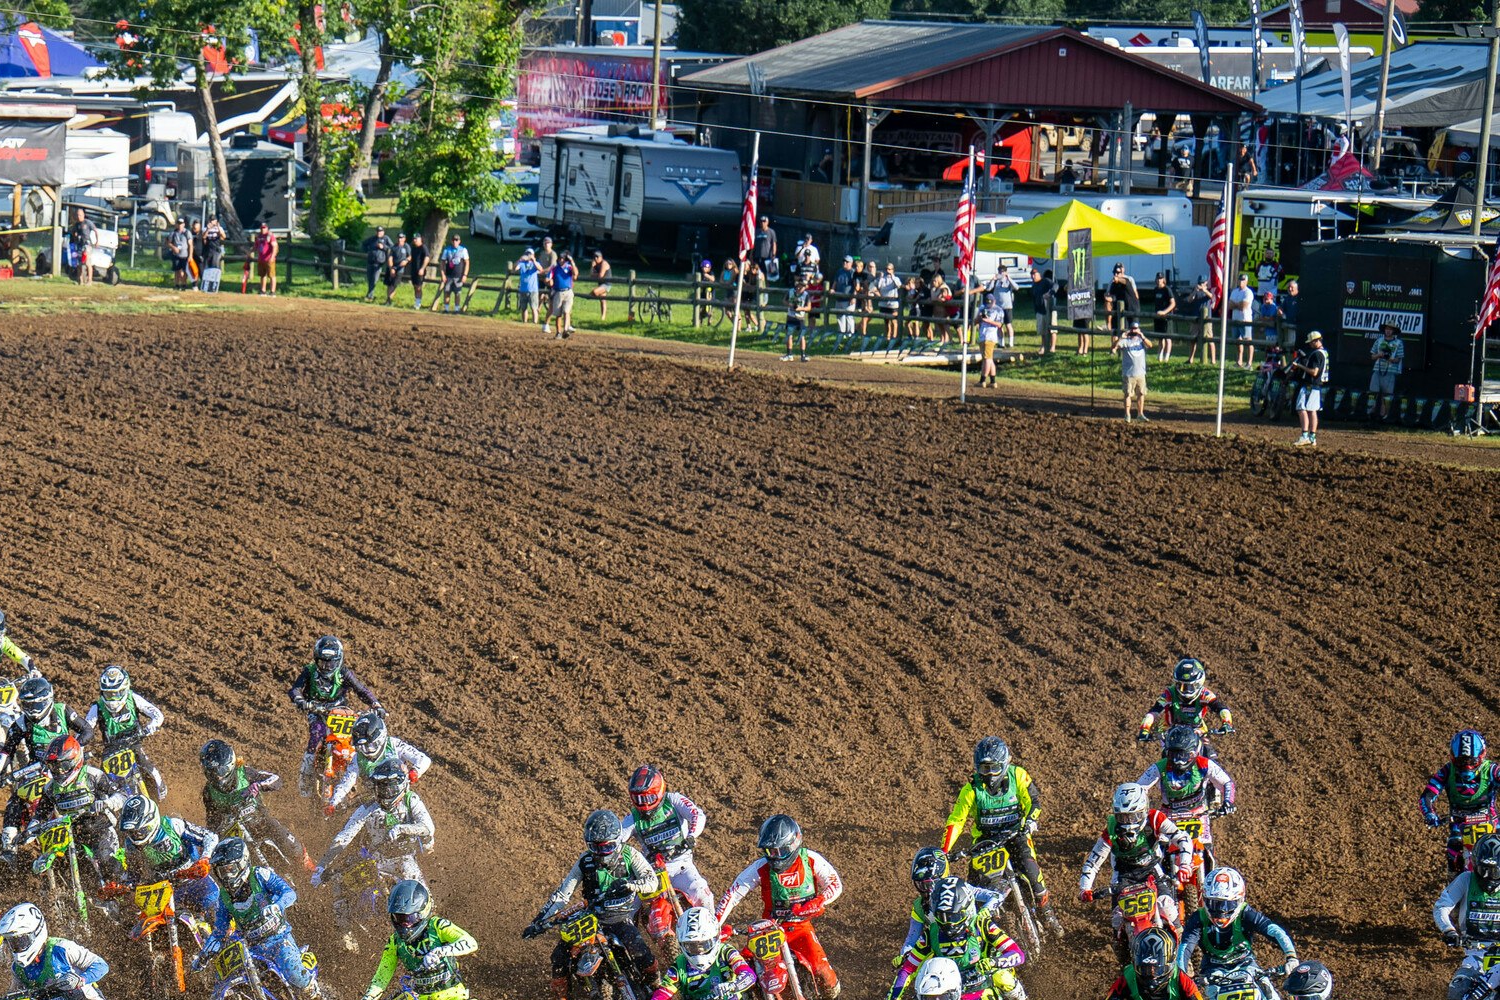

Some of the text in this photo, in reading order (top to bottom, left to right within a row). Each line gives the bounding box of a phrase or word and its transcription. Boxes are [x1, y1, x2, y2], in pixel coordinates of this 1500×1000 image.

[624, 83, 653, 101] RACIN
[1250, 228, 1282, 240] YOU
[1254, 217, 1282, 229] DID
[1246, 239, 1280, 250] SEE
[1344, 309, 1422, 333] CHAMPIONSHIP
[108, 751, 134, 775] 88
[977, 851, 1004, 874] 30
[781, 873, 797, 886] FLY
[141, 888, 166, 911] 77
[1123, 893, 1153, 916] 59
[565, 916, 597, 944] 32
[755, 933, 781, 957] 85
[998, 953, 1021, 968] FXR
